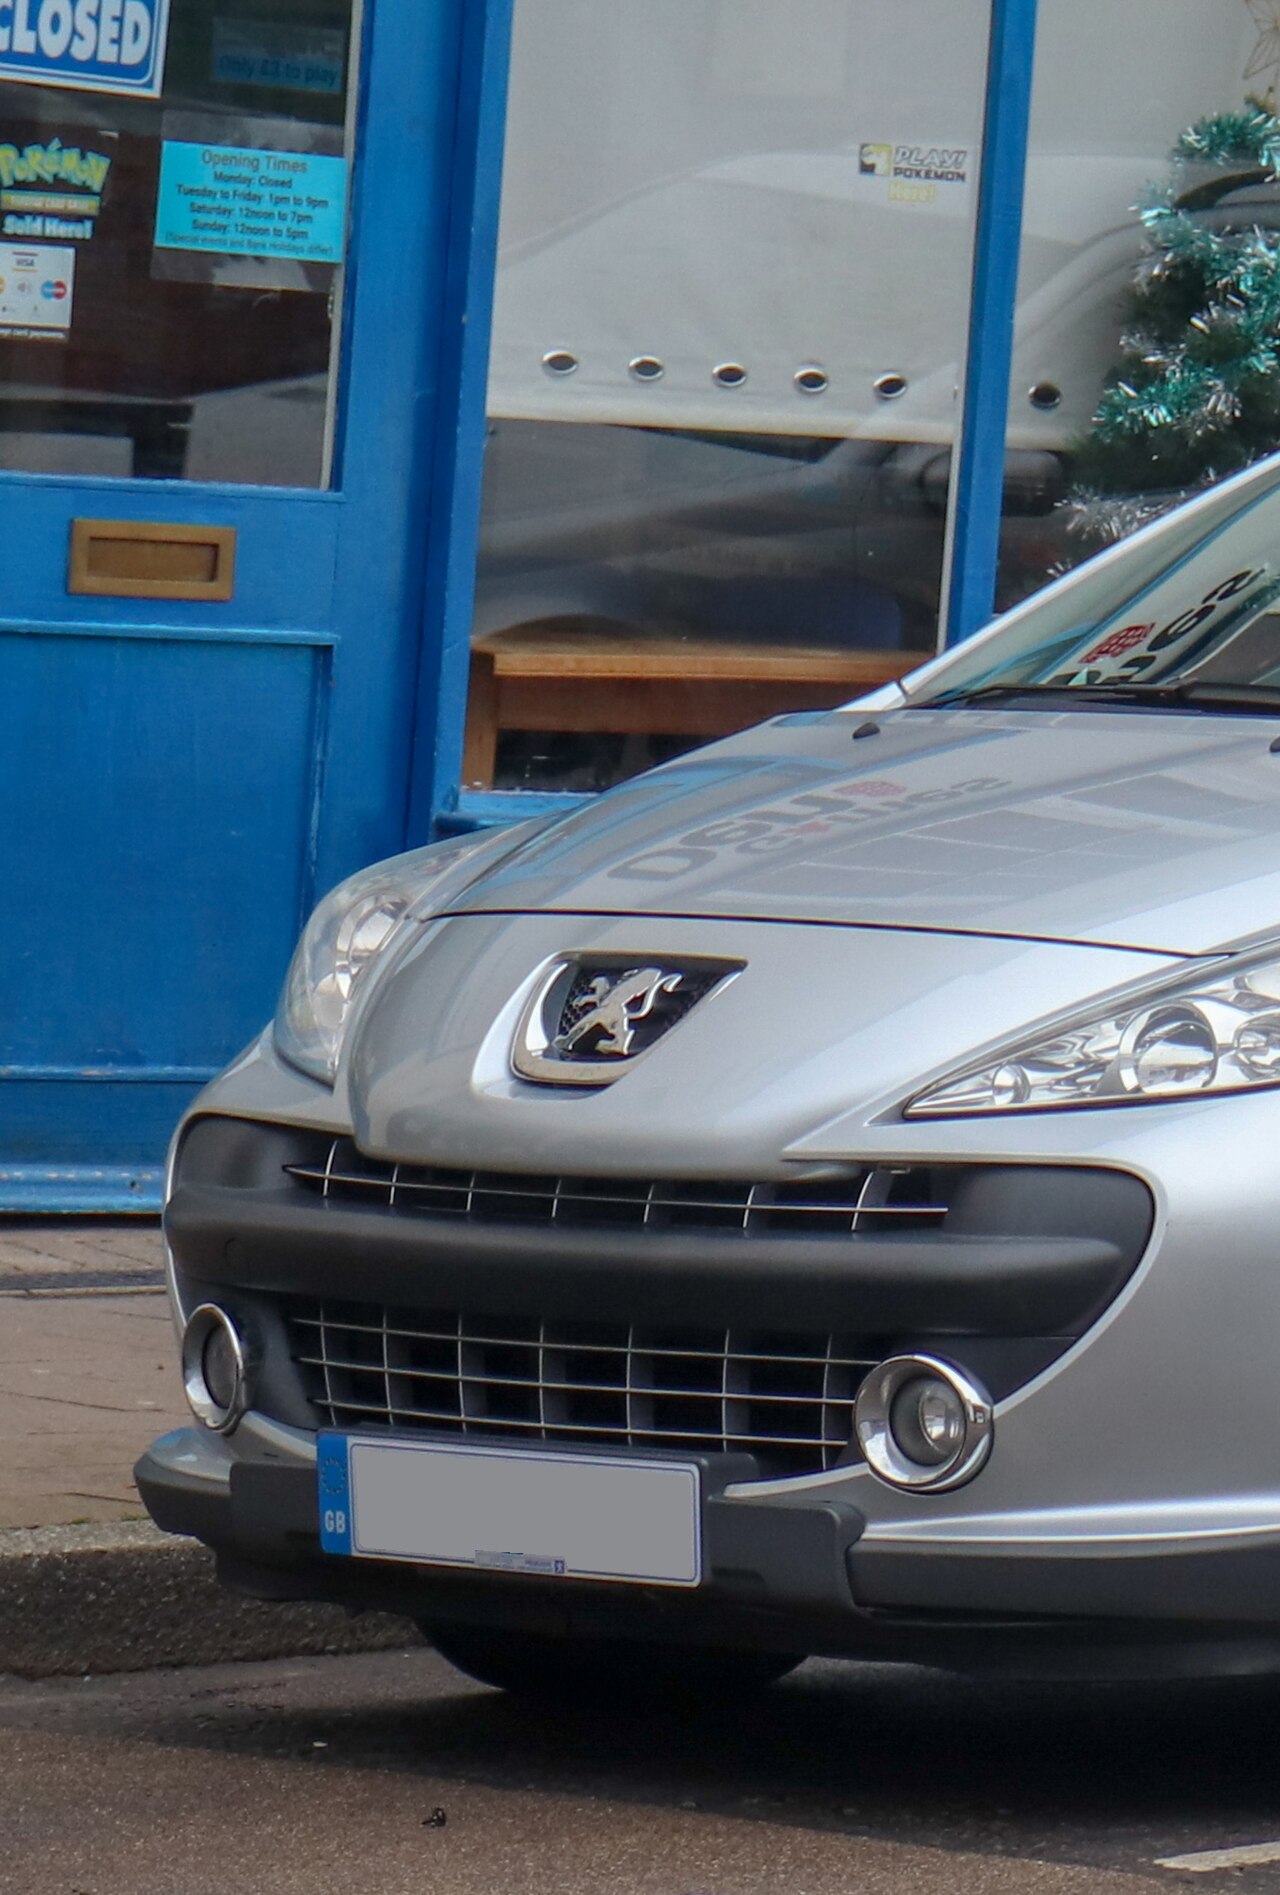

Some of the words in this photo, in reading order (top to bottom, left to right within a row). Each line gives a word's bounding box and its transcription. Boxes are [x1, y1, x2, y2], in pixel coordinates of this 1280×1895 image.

[201, 149, 260, 172] Opening
[265, 154, 308, 174] Times
[894, 145, 968, 170] PLAY!
[213, 171, 255, 188] Monday:
[258, 175, 293, 189] Closed
[176, 184, 217, 200] Tuesday
[219, 188, 230, 200] to
[269, 192, 290, 206] 1pm
[293, 195, 303, 205] to
[2, 213, 43, 236] Sold
[277, 209, 288, 221] to
[291, 211, 313, 225] 7pm
[272, 225, 283, 237] to
[324, 1509, 347, 1534] GB
